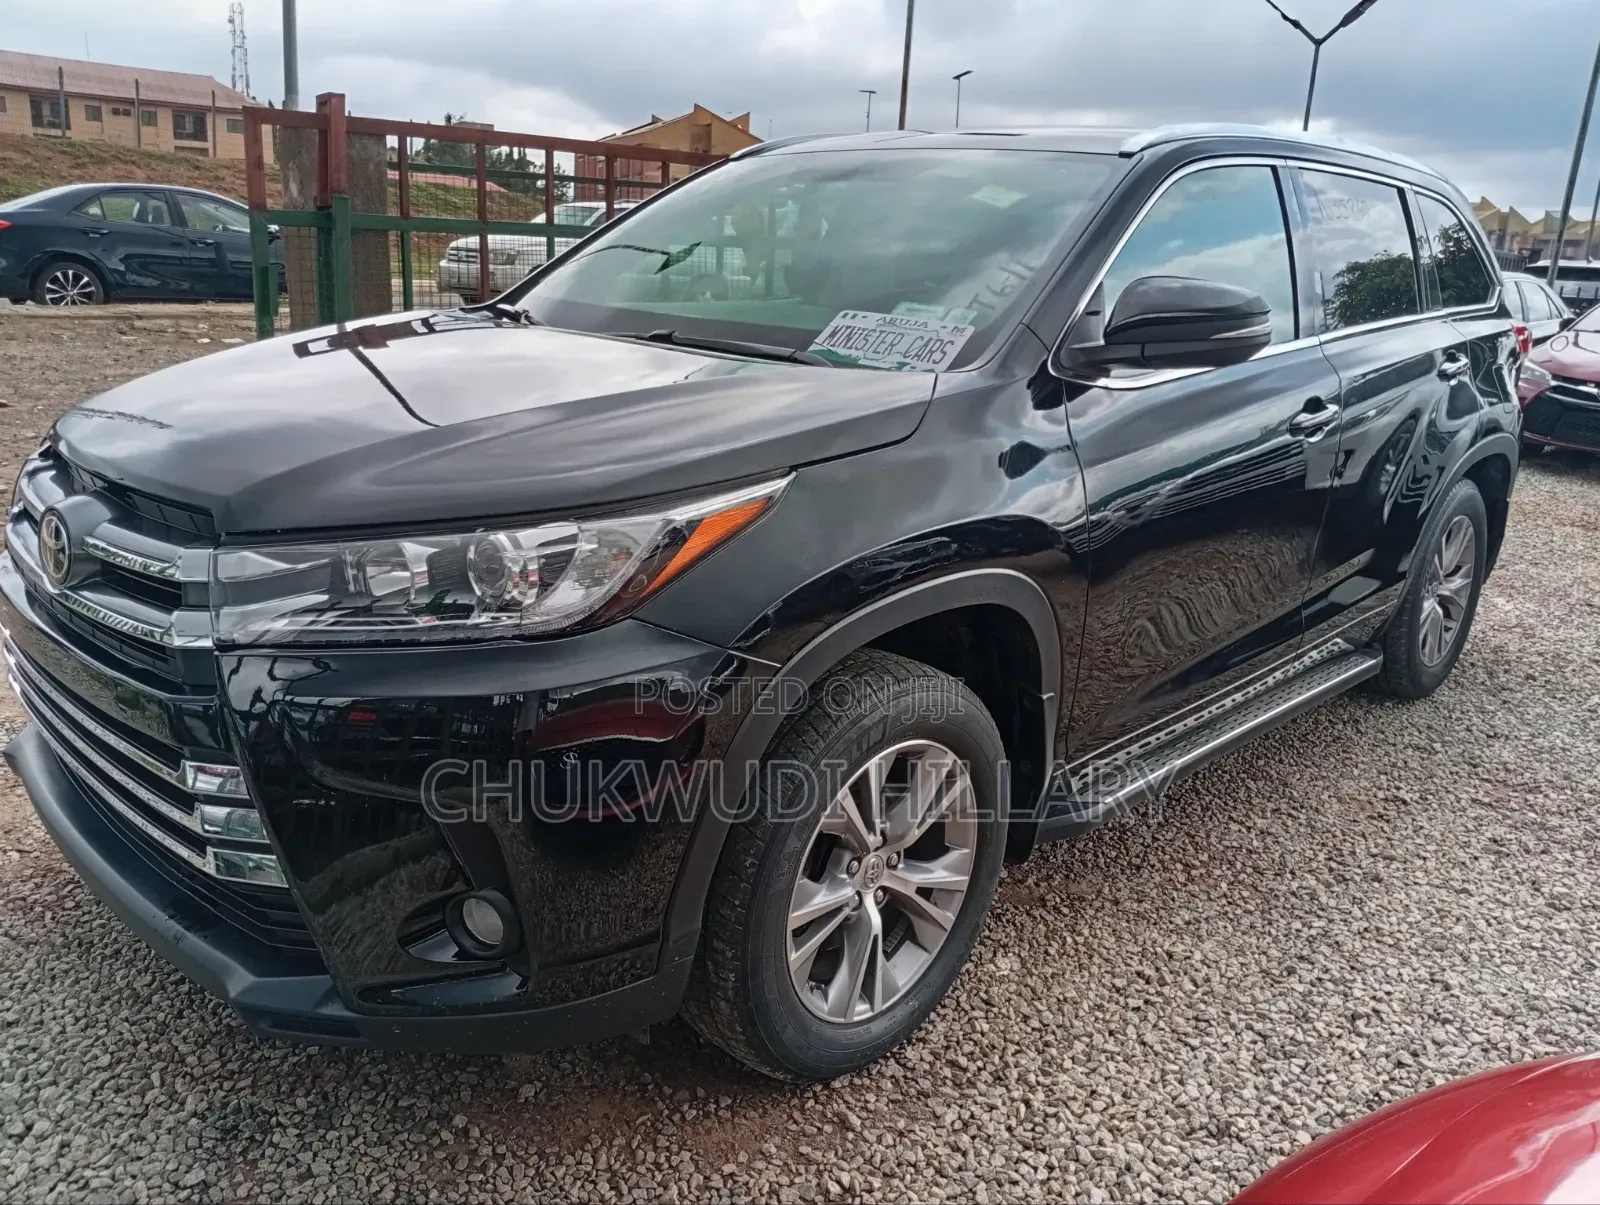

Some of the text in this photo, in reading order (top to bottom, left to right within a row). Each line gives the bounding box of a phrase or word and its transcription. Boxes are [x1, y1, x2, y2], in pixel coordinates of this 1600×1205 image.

[876, 316, 929, 329] ABUJA
[821, 324, 955, 365] MINISTER CARS
